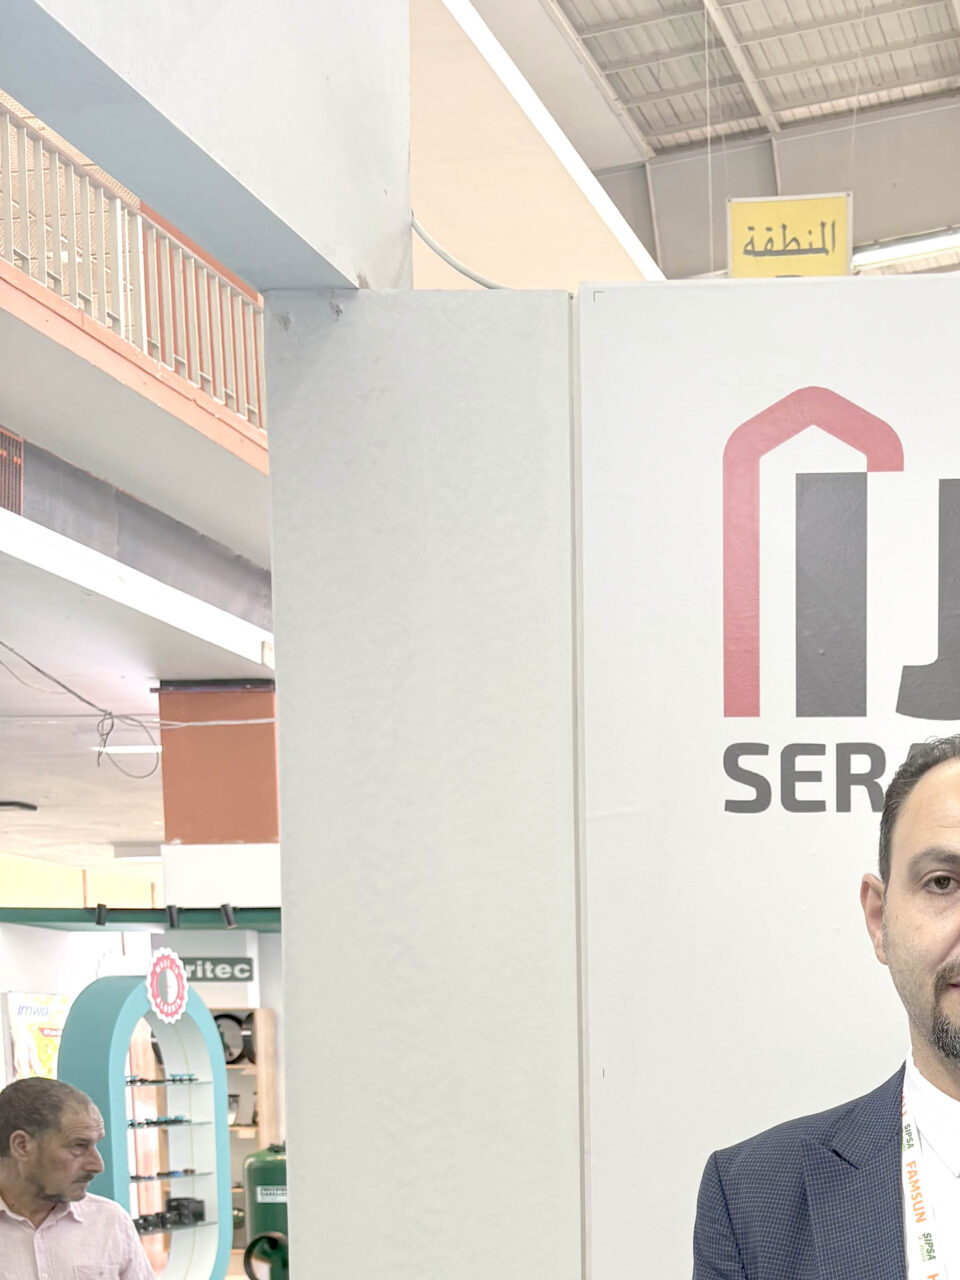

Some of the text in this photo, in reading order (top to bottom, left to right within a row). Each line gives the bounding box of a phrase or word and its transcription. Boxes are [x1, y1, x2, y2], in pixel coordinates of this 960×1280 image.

[904, 1123, 915, 1150] SIPSA
[905, 1160, 927, 1224] FAMSUN
[923, 1232, 937, 1262] SIPSA
